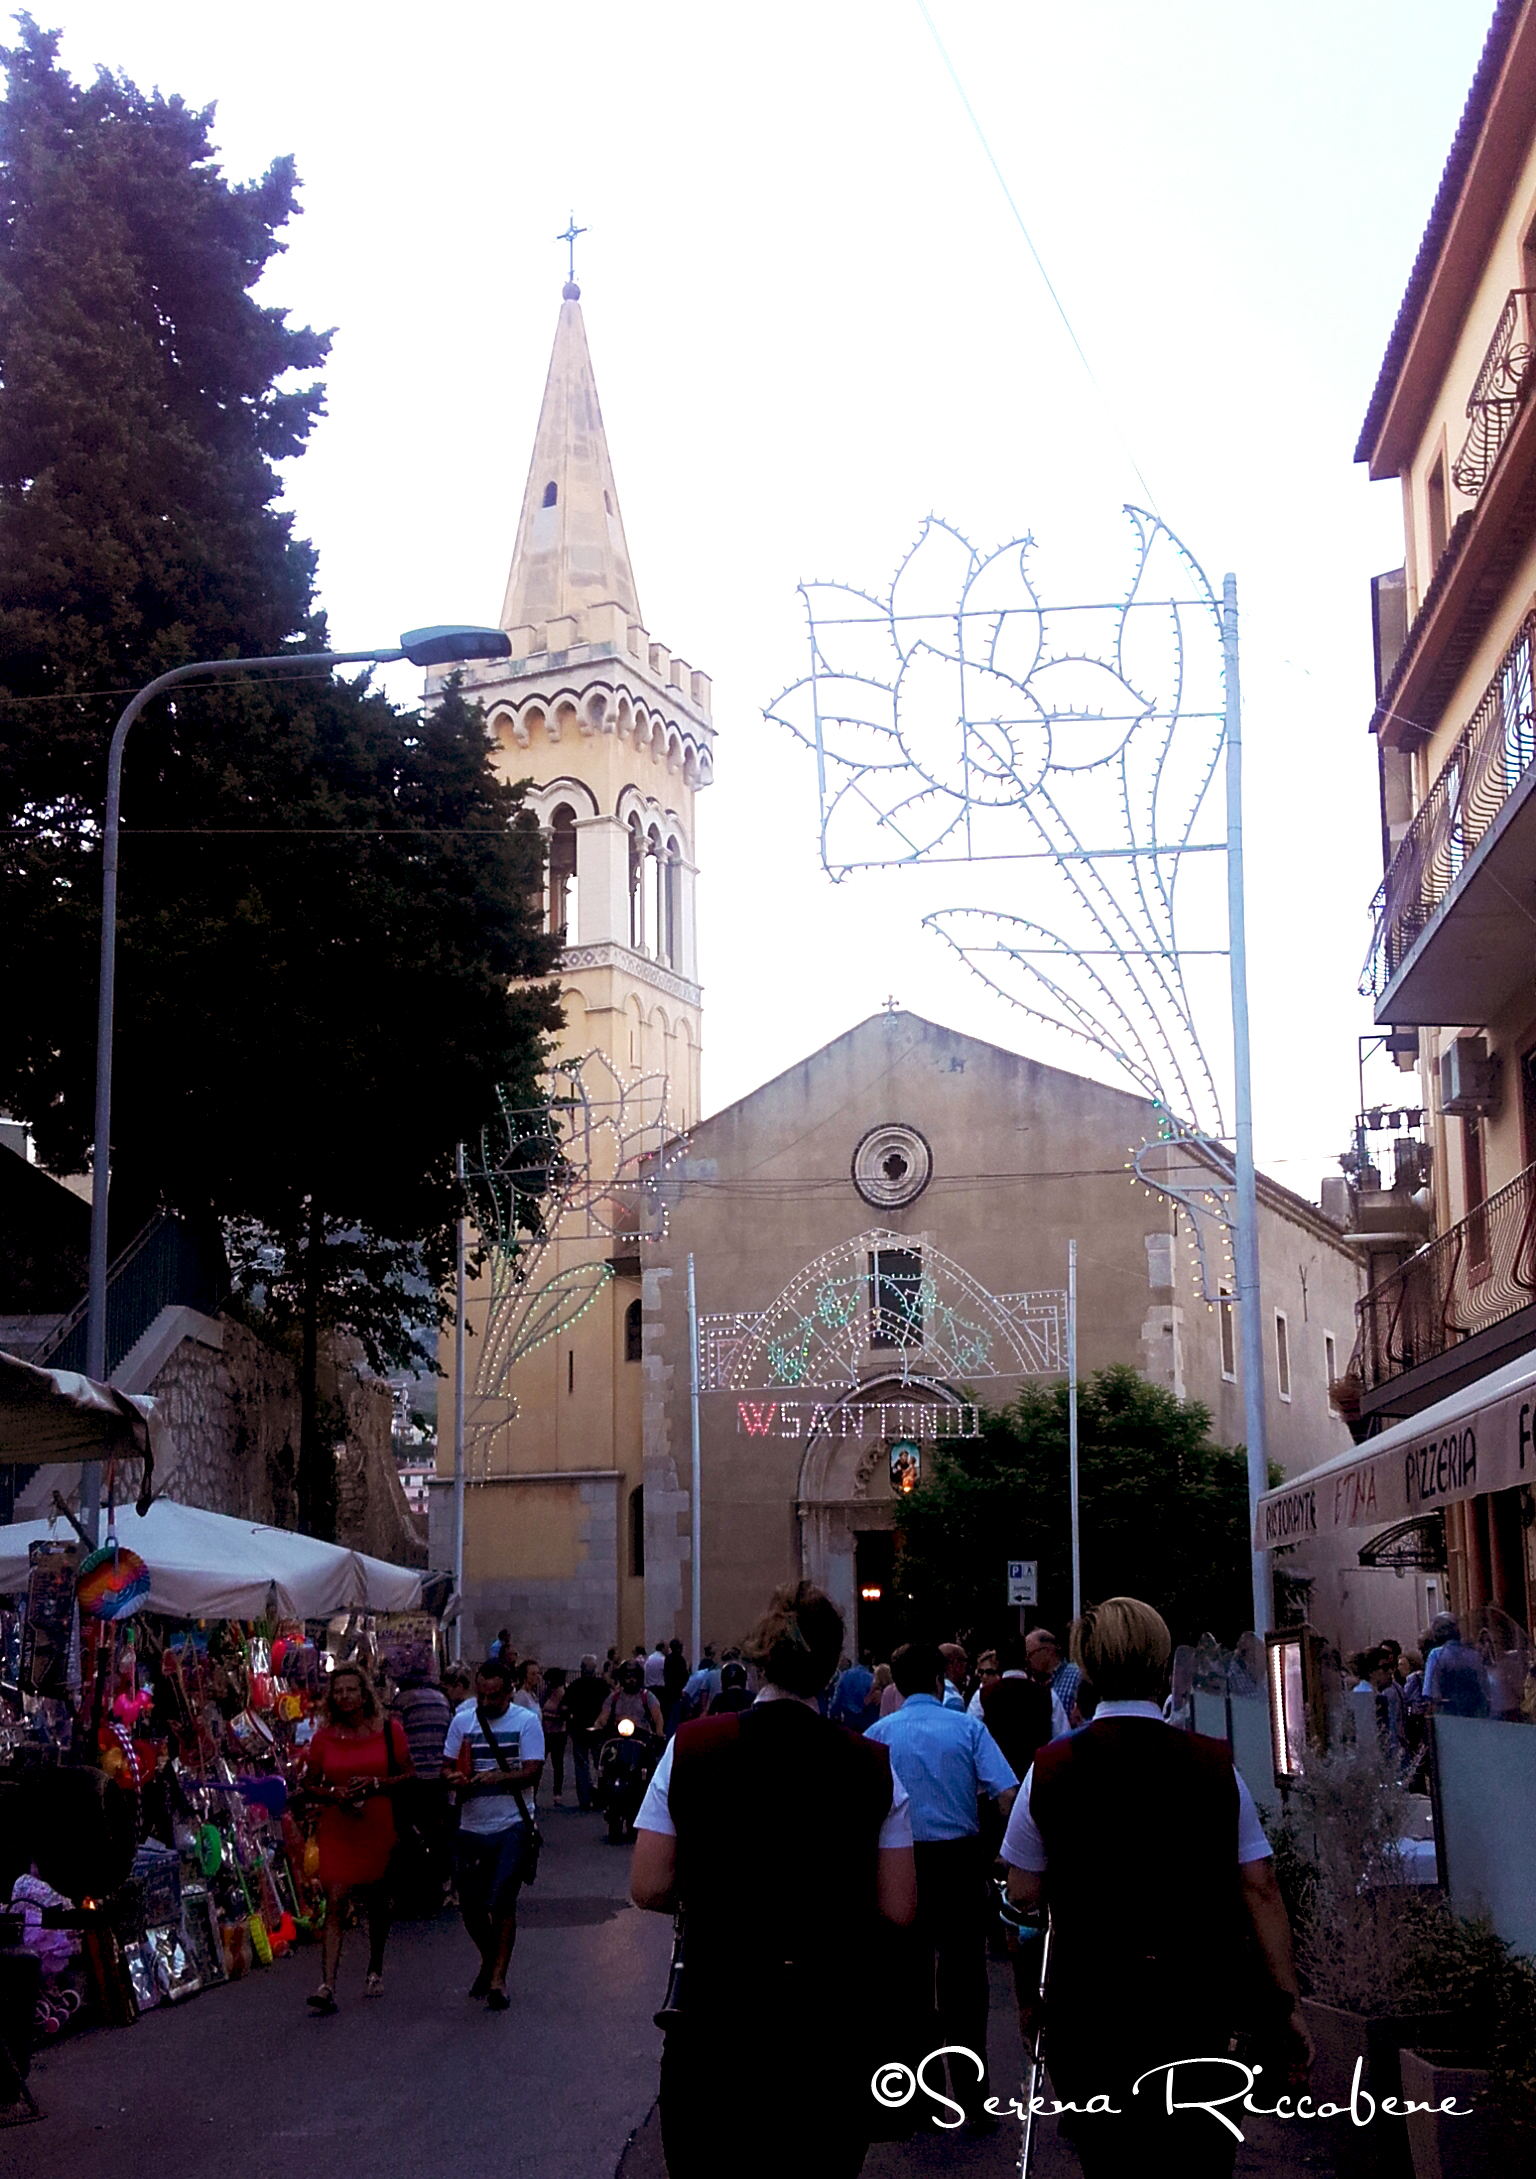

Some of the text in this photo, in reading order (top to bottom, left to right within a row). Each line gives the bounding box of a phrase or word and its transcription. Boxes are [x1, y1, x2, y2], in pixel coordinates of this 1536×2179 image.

[1266, 1491, 1317, 1541] RISTORANTE
[1335, 1467, 1378, 1525] ETNA
[1405, 1426, 1477, 1504] PIZZERIA
